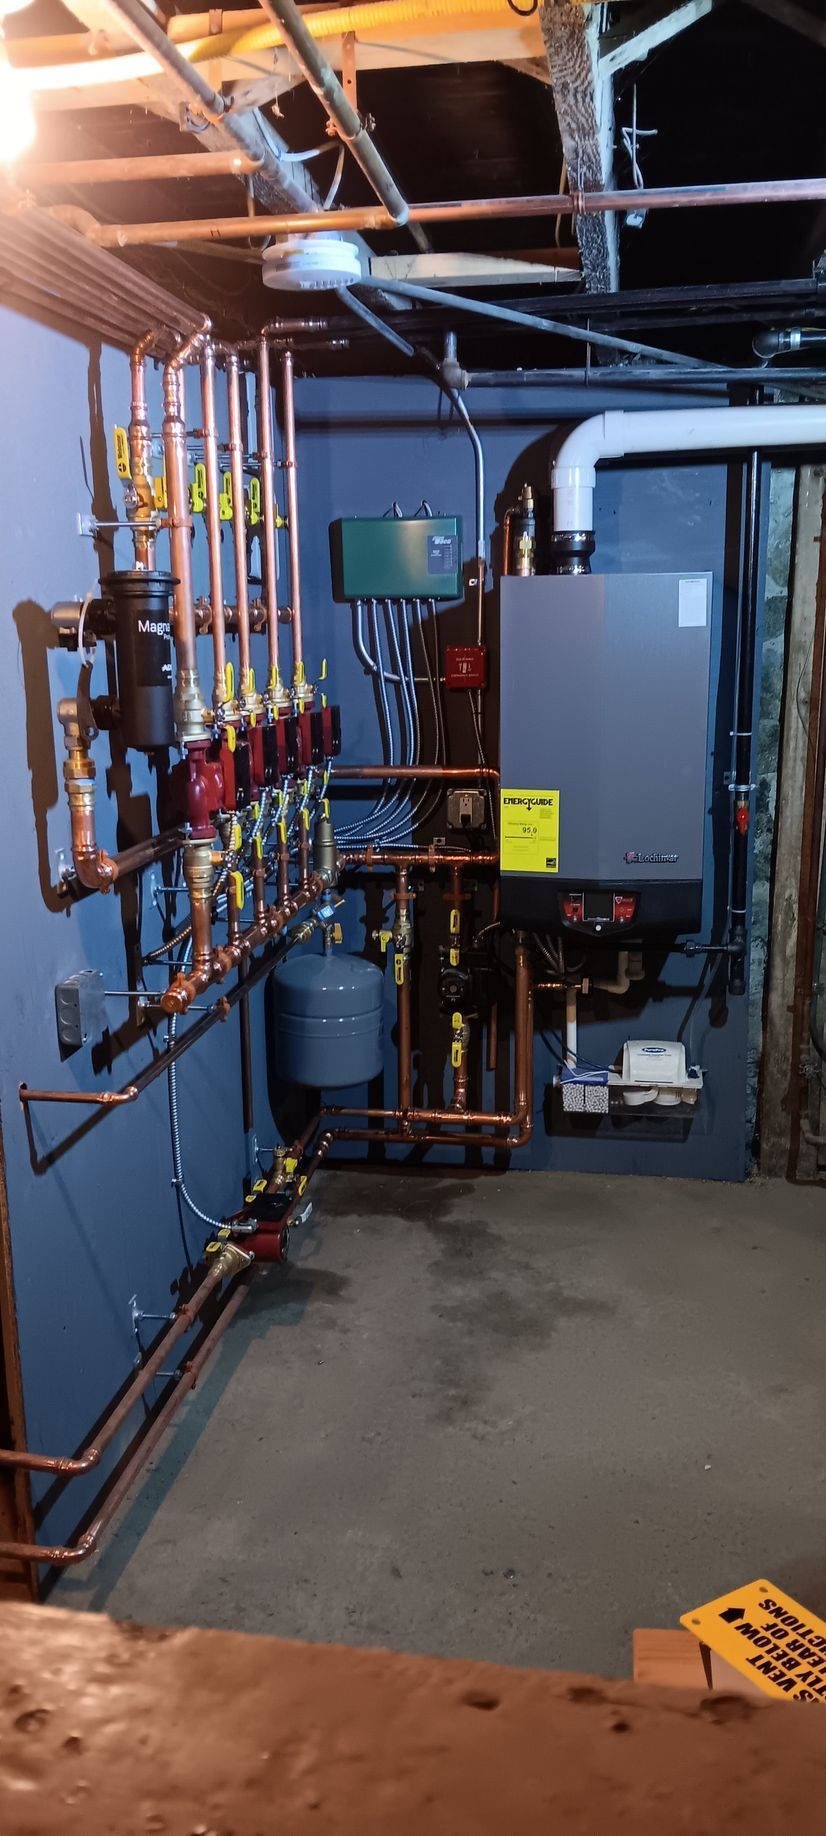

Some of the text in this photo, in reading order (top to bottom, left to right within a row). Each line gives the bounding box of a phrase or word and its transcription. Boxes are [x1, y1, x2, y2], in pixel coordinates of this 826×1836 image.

[638, 853, 678, 863] Lochinvar
[760, 1623, 789, 1640] OF
[734, 1623, 826, 1699] TLY BELOW
[746, 1654, 797, 1692] VENT
